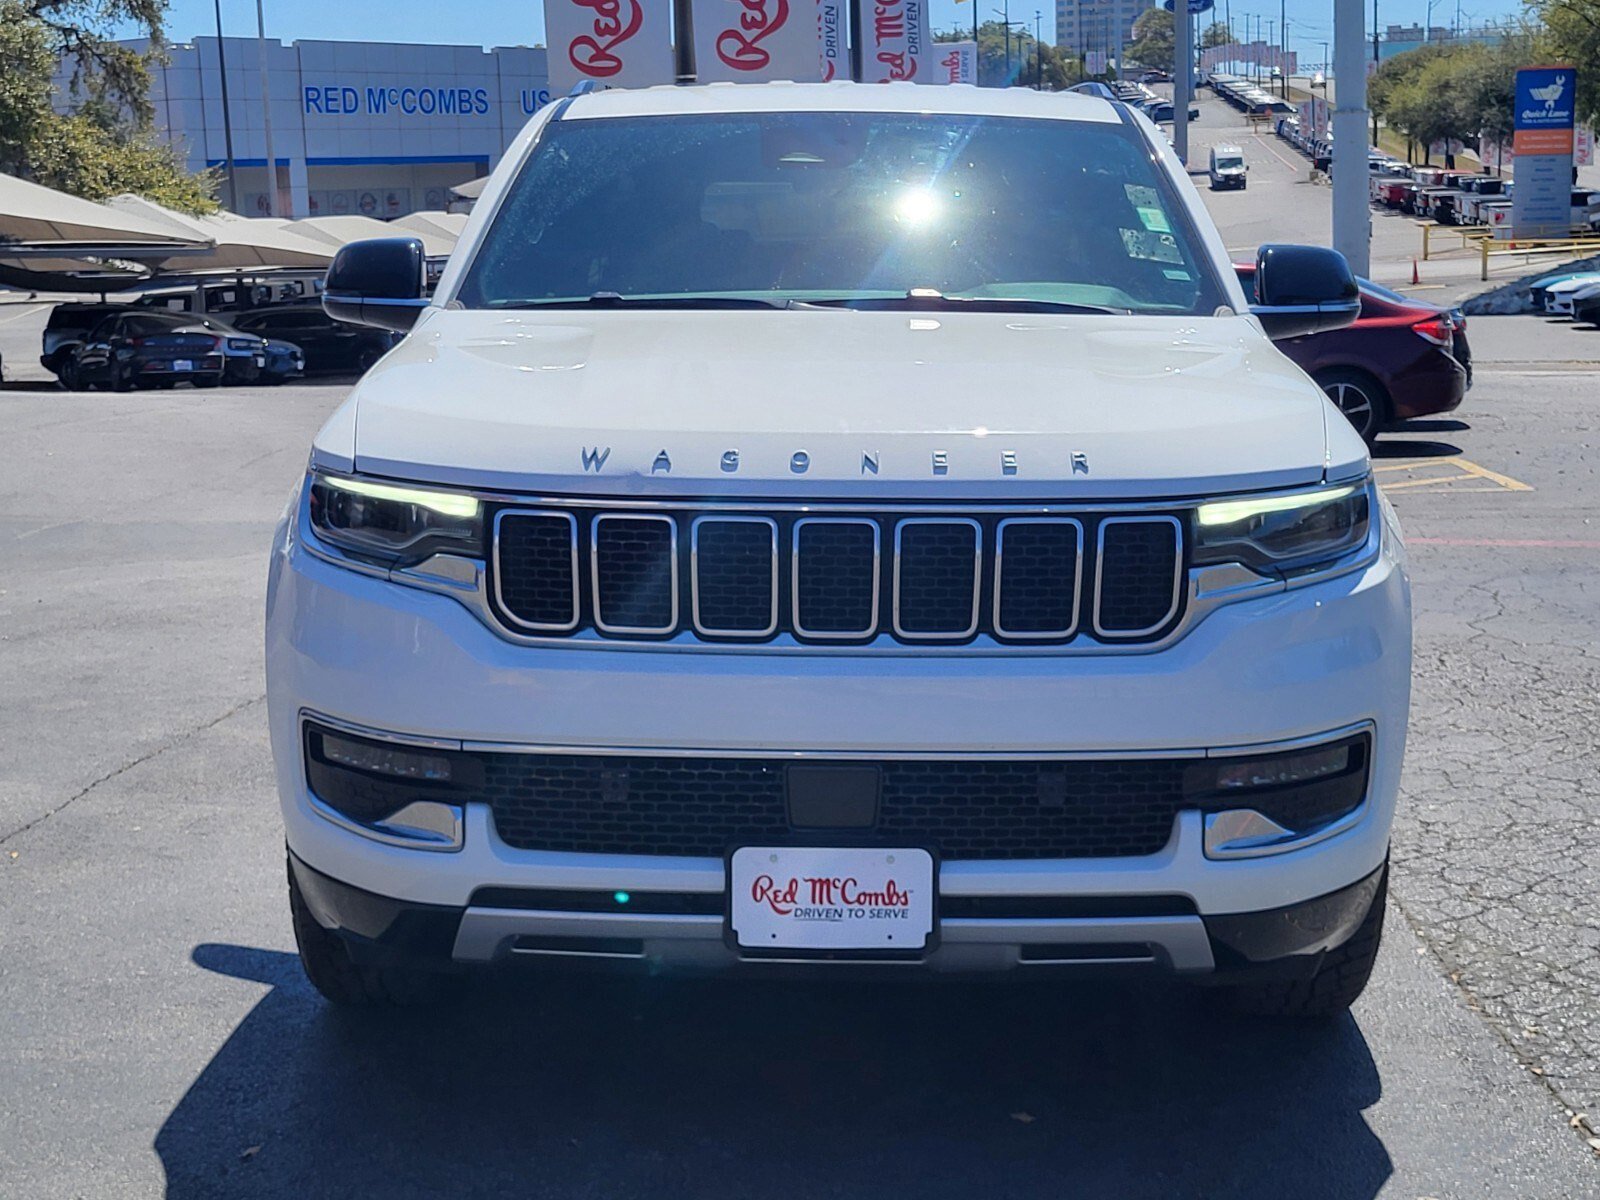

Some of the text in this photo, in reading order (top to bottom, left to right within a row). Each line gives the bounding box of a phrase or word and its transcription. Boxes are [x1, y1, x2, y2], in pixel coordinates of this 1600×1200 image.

[825, 5, 837, 58] DRIVEN
[906, 2, 919, 55] DRIVEN
[304, 86, 360, 115] RED
[581, 446, 1090, 475] WAGONEER
[752, 874, 909, 915] Red McCombs
[793, 907, 910, 920] DRIVEN TO SERVE
